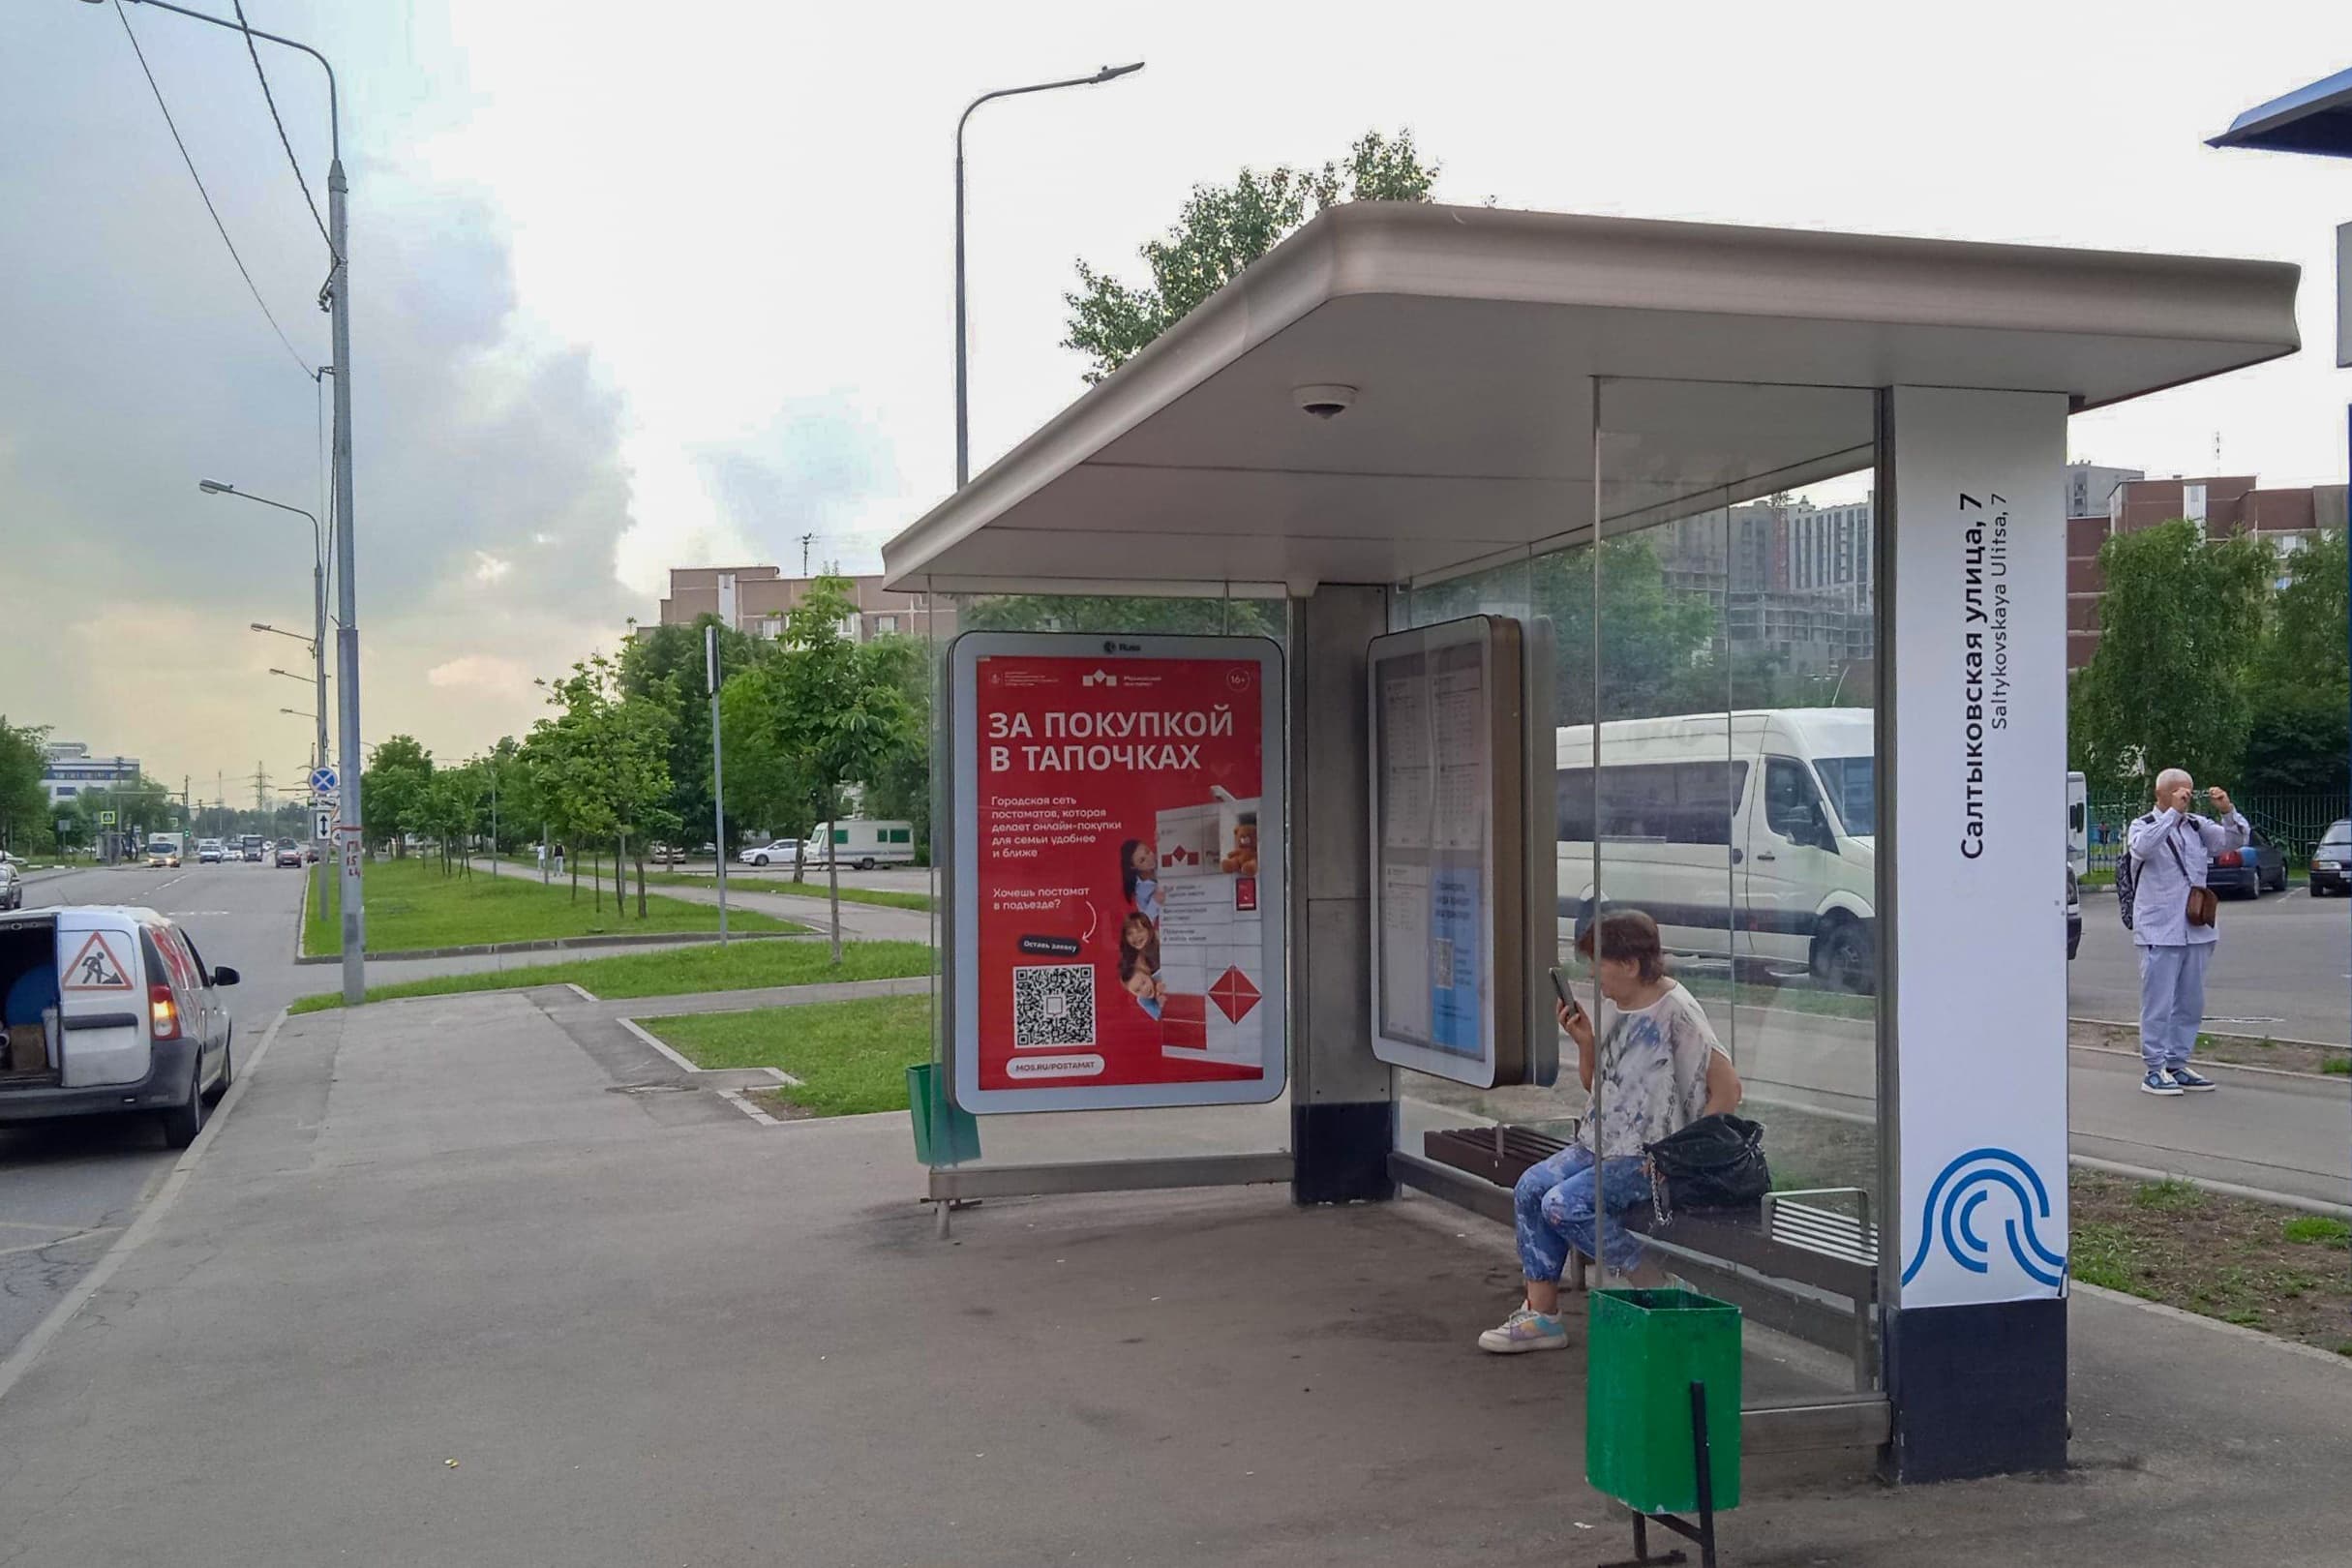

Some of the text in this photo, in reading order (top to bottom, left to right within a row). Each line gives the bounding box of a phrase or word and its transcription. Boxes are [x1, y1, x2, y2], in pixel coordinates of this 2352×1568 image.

[1991, 493, 2010, 730] Saltykovskaya Ulitsa, 7
[1960, 492, 1988, 860] Салтыковская улица, 7
[988, 704, 1233, 739] ЗА ПОКУПКОЙ
[990, 744, 1201, 772] В ТАПОЧКАХ
[991, 797, 1077, 807] Городская сеть
[1063, 809, 1106, 819] которая
[992, 821, 1122, 832] делает онлайн-покупки
[992, 833, 1097, 846] для семьи удобнее
[1003, 848, 1038, 858] ближе
[993, 888, 1036, 898] Хочешь
[1003, 898, 1061, 911] подъезде?
[1023, 940, 1051, 950] Оставь
